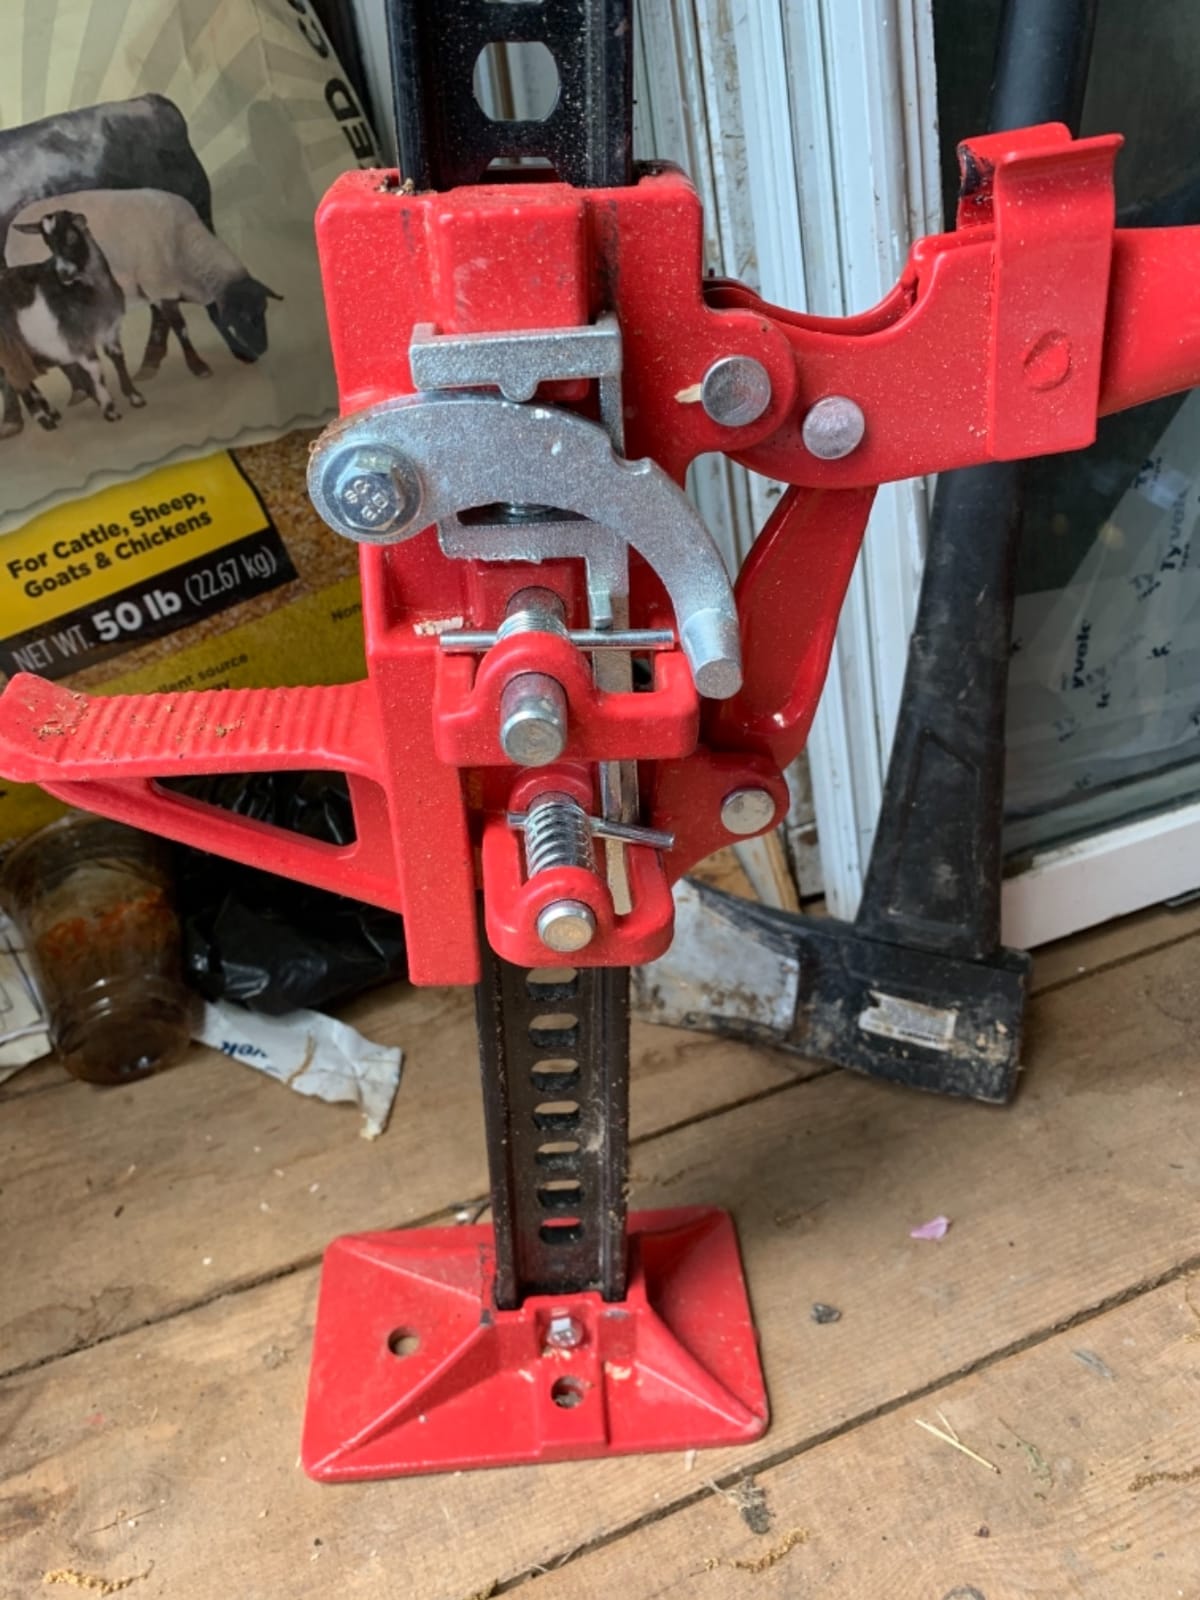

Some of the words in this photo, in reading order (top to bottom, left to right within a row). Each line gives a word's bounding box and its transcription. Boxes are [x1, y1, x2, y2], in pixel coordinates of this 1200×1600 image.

[6, 552, 47, 580] For
[53, 523, 130, 560] Cattle,
[130, 491, 206, 528] Sheep,
[24, 562, 92, 599] Goats
[95, 552, 113, 570] &
[115, 511, 213, 561] Chickens
[11, 640, 54, 671] NET
[50, 624, 94, 657] WT.
[92, 603, 143, 641] 50
[142, 590, 182, 620] lb
[184, 559, 241, 606] (22.67
[241, 546, 277, 579] kg)
[198, 653, 248, 681] source
